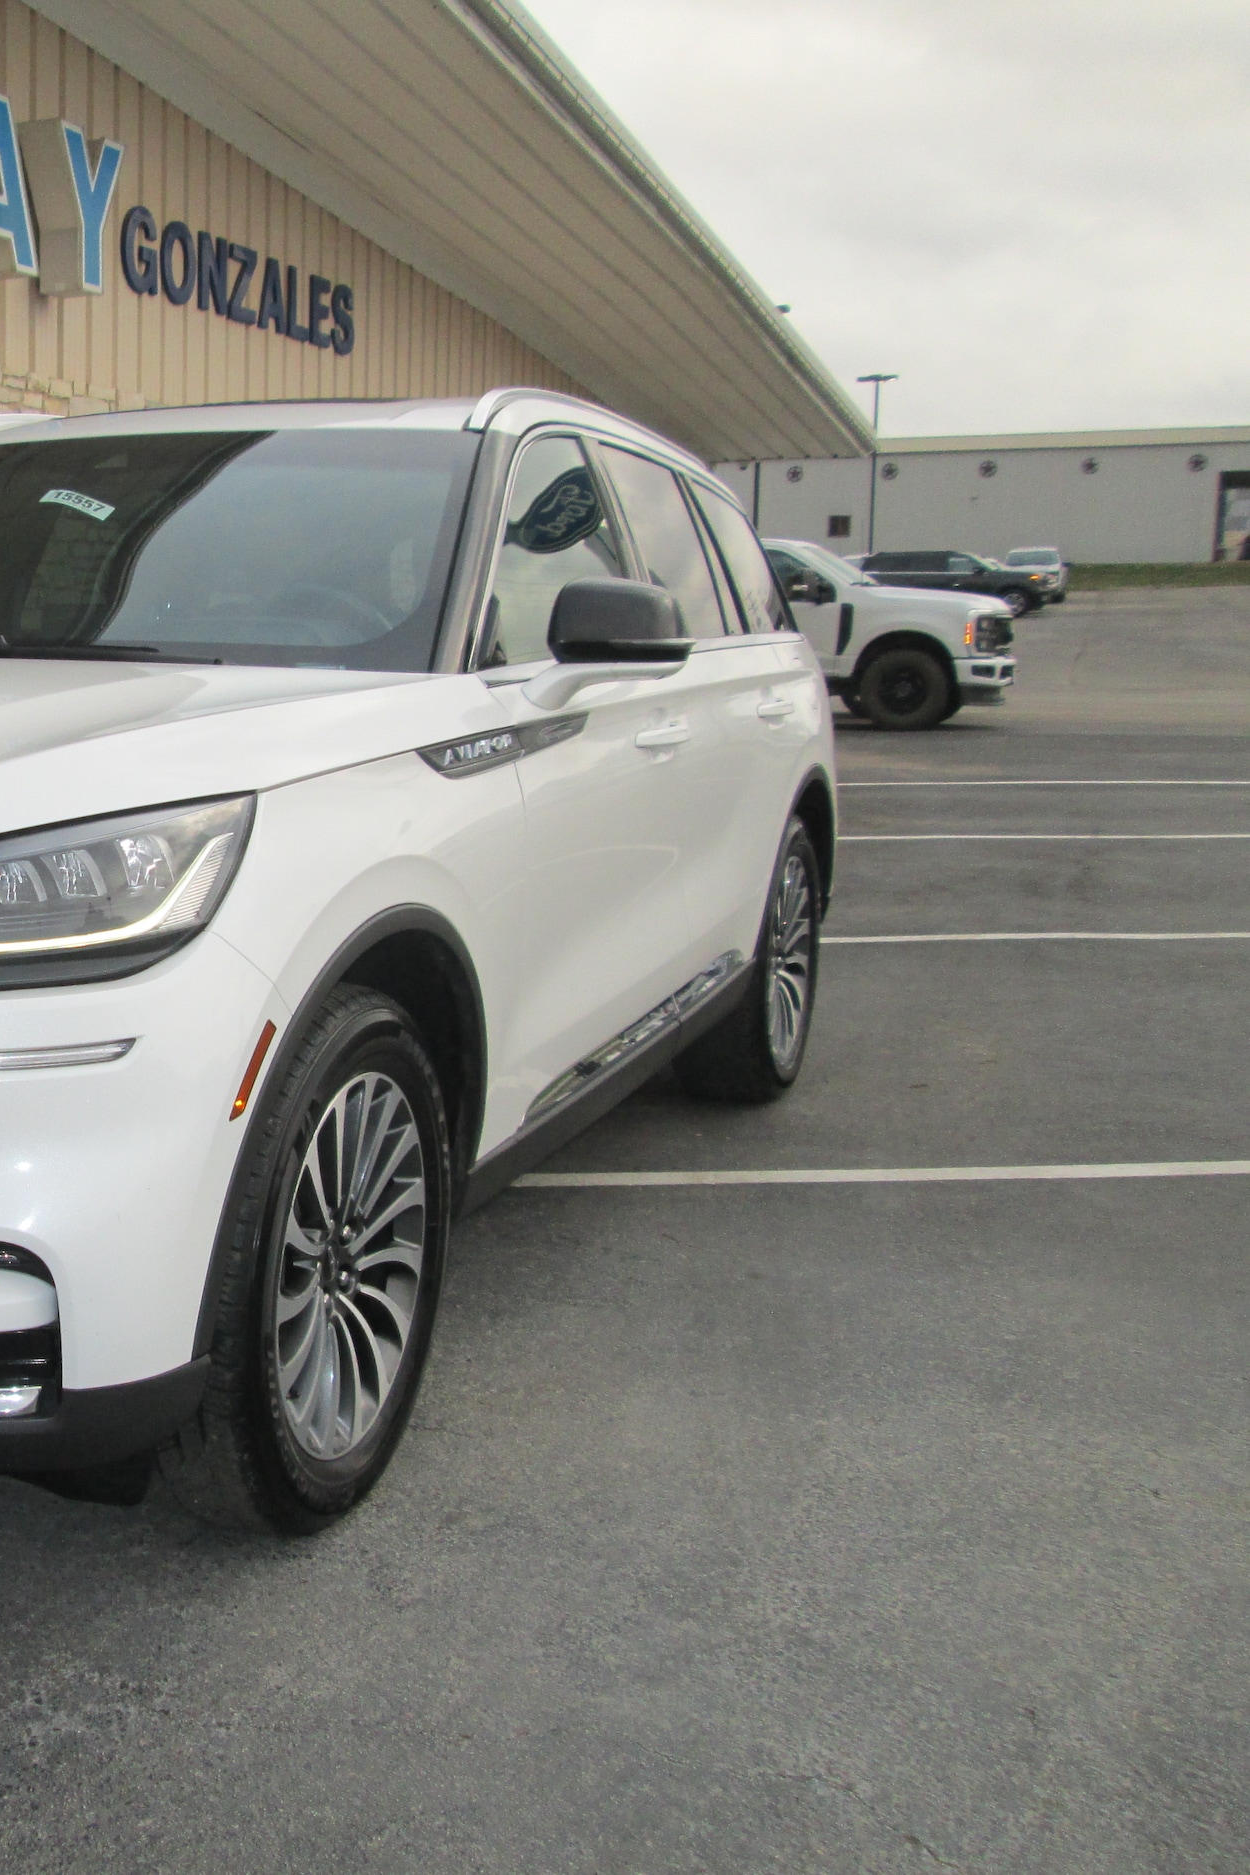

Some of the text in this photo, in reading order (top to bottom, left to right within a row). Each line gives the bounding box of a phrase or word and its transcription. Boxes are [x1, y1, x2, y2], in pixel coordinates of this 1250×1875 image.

[120, 205, 355, 356] GONZALES
[53, 491, 106, 512] 15557
[443, 733, 513, 766] AVIATOR
